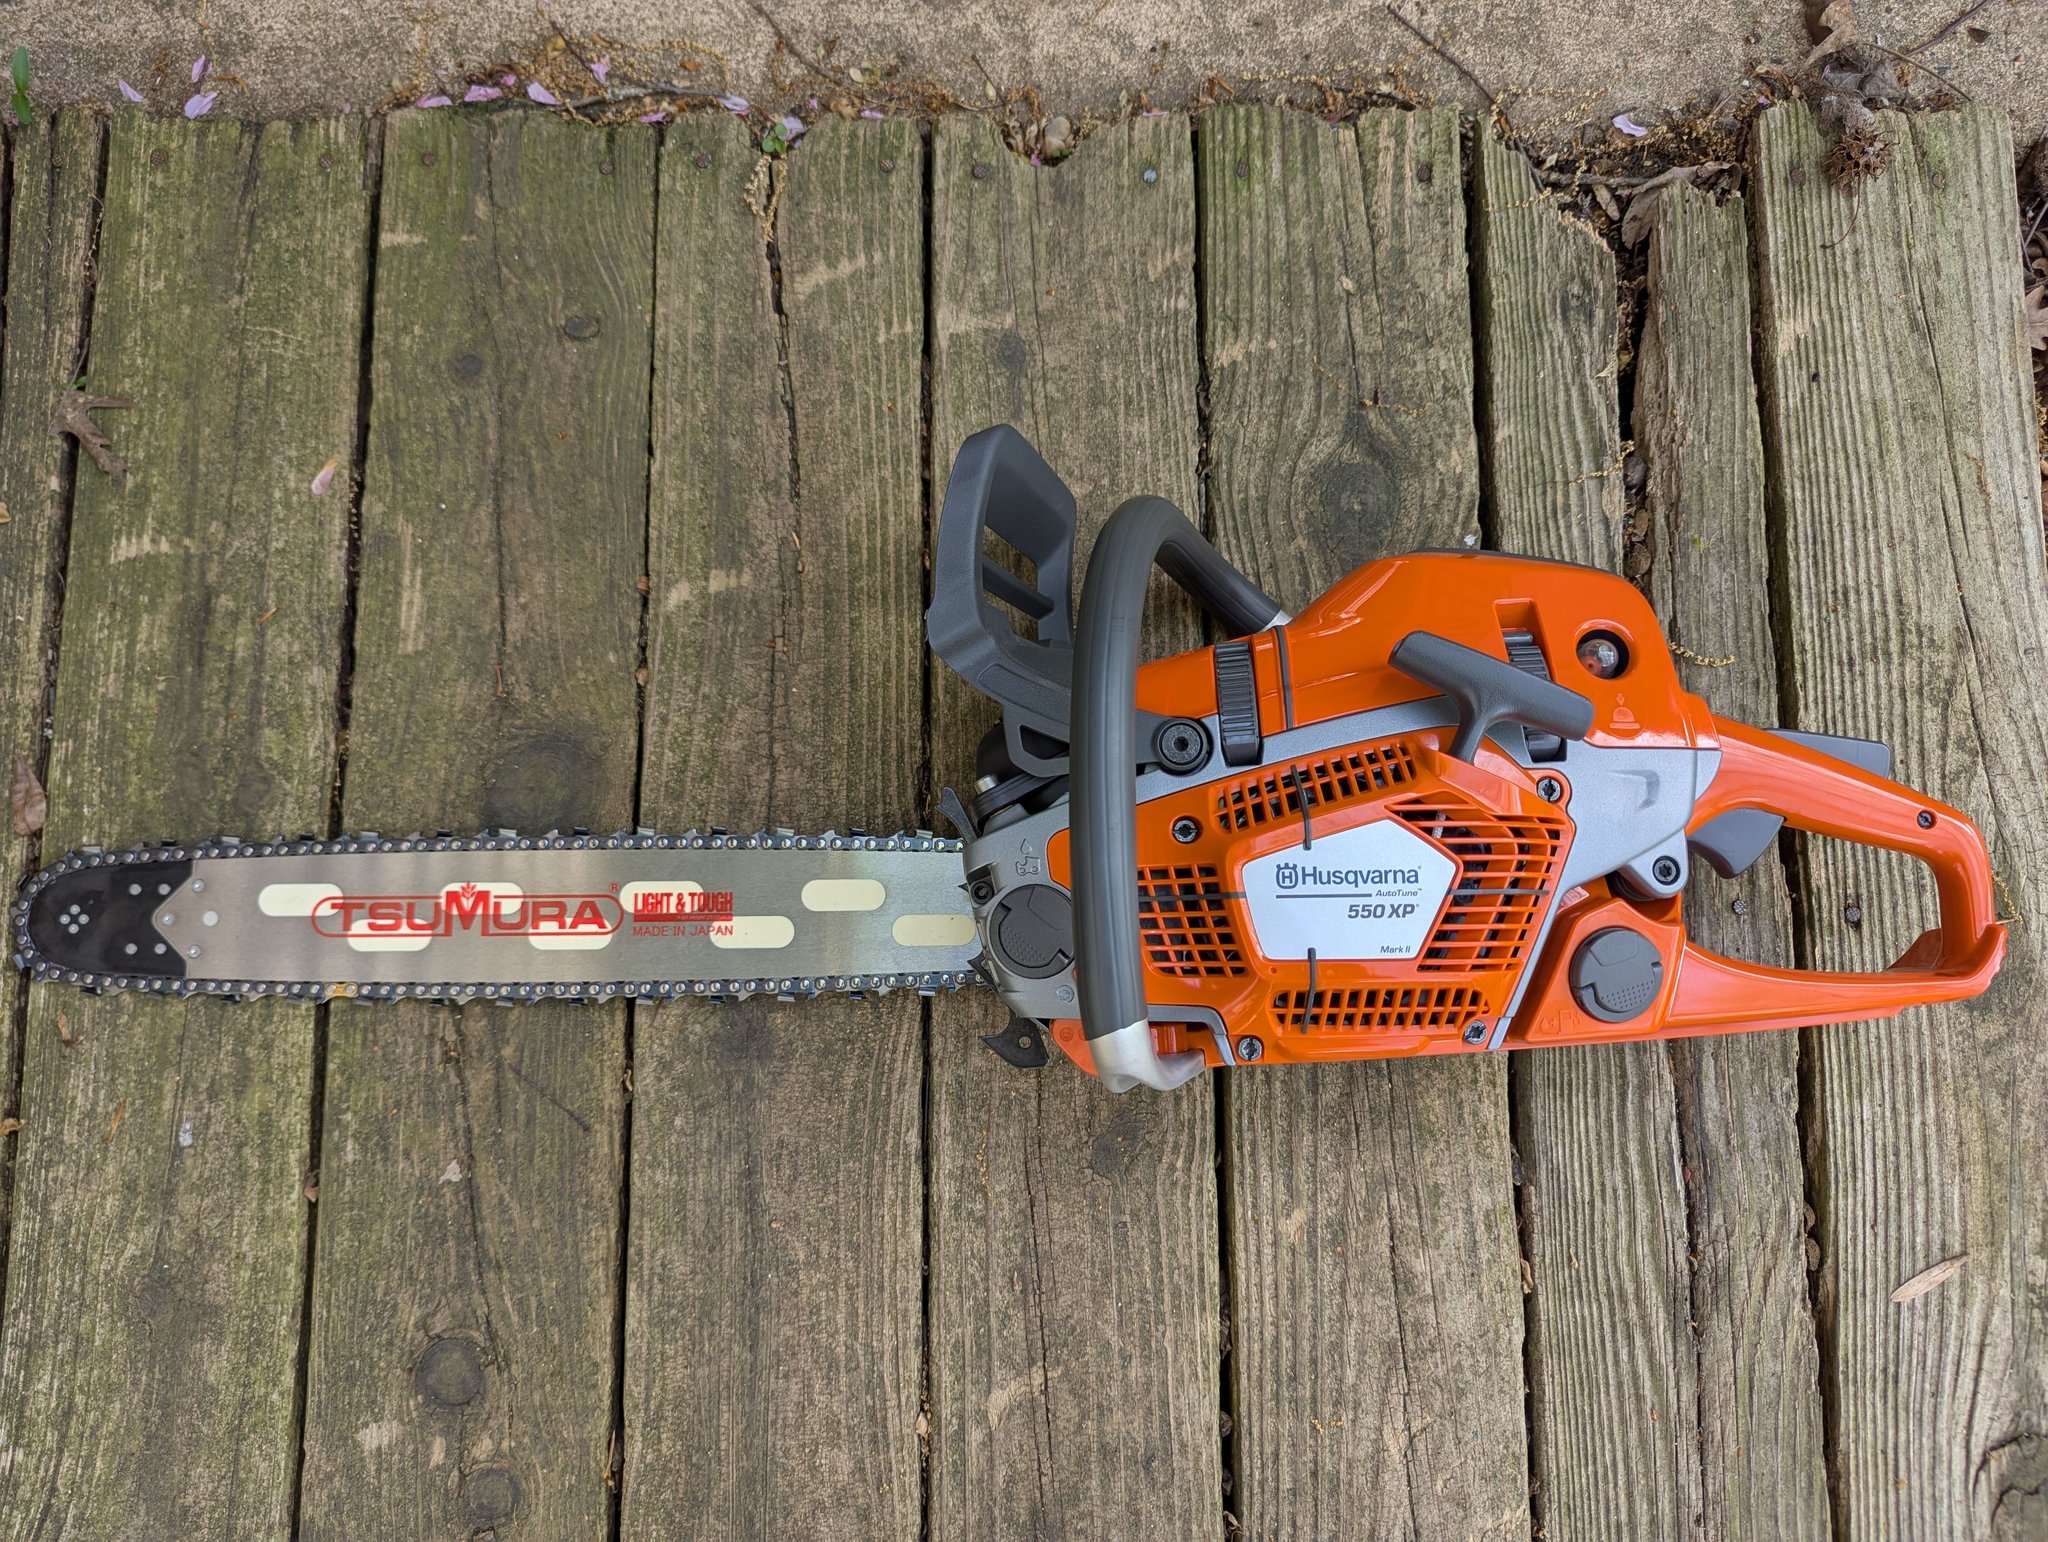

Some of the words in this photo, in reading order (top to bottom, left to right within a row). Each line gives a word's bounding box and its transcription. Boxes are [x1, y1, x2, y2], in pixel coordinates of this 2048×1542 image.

[1301, 866, 1419, 888] Husqvarna
[1375, 888, 1419, 897] AutoTune
[634, 892, 673, 913] LIGHT
[676, 892, 686, 913] &
[688, 891, 733, 912] TOUGH
[330, 889, 609, 936] TSUMURA
[1347, 904, 1386, 918] 550
[1387, 904, 1416, 918] XP
[632, 925, 669, 936] MADE
[673, 925, 685, 936] IN
[690, 925, 733, 936] JAPAN
[1380, 945, 1403, 954] Mark
